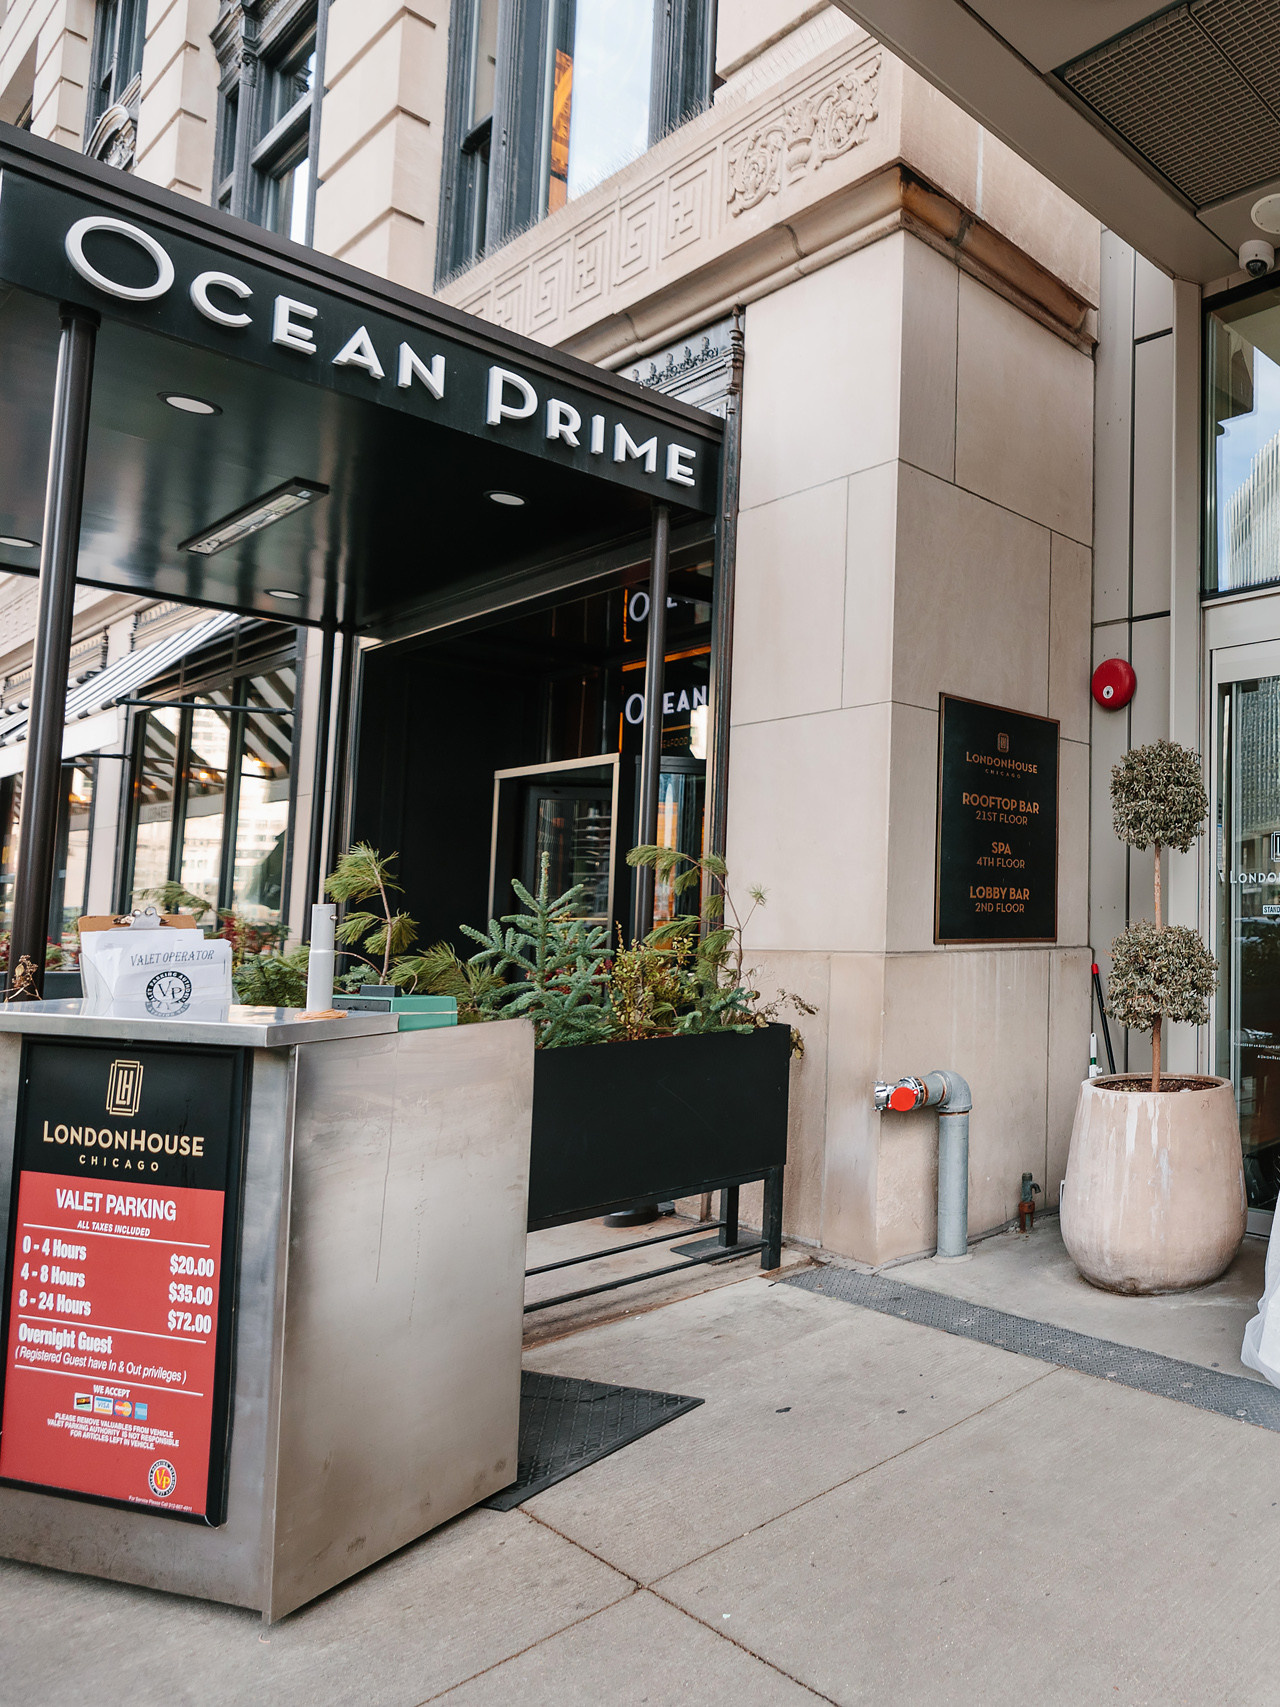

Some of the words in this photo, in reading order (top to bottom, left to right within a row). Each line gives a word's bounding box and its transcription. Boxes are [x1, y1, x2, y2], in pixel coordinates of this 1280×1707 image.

[64, 215, 446, 399] OCEAN
[486, 366, 697, 487] PRIME
[625, 685, 707, 725] OEAN
[966, 751, 1038, 774] LONDONHOUSE
[985, 768, 1021, 779] CHICAGO
[962, 792, 1018, 811] ROOFTOP
[1019, 800, 1040, 815] BAR
[976, 810, 998, 822] 21ST
[999, 813, 1028, 825] FLOOR
[991, 841, 1012, 855] SPA
[976, 856, 995, 867] 4TH
[996, 858, 1025, 869] FLOOR
[969, 885, 1008, 900] LOBBY
[1009, 887, 1030, 901] BAR
[975, 902, 994, 913] 2ND
[996, 903, 1025, 913] FLOOR
[130, 953, 162, 966] VALET
[162, 949, 215, 964] OPERATOR
[43, 1120, 205, 1157] LONDONHOUSE
[79, 1154, 159, 1172] CHICAGO
[56, 1188, 104, 1213] VALET
[105, 1194, 177, 1221] PARKING
[77, 1220, 90, 1230] ALL
[92, 1222, 113, 1233] TAXES
[114, 1224, 151, 1237] INCLUDED
[22, 1235, 32, 1254] 0
[41, 1238, 51, 1256] 4
[52, 1239, 87, 1261] Hours
[20, 1262, 30, 1280] 4
[39, 1264, 49, 1283] 8
[51, 1265, 86, 1288] Hours
[169, 1253, 215, 1278] $20.00
[18, 1289, 28, 1307] 8
[38, 1291, 54, 1311] 24
[56, 1294, 92, 1316] Hours
[168, 1281, 214, 1306] $35.00
[167, 1309, 212, 1334] $72.00
[18, 1323, 76, 1350] Overnight
[78, 1331, 113, 1354] Guest
[63, 1352, 87, 1367] Guest
[87, 1356, 108, 1370] have
[108, 1359, 117, 1372] In
[118, 1360, 125, 1373] &
[126, 1361, 142, 1376] Out
[93, 1384, 105, 1394] WE
[105, 1386, 131, 1398] ACCEPT
[97, 1401, 110, 1409] VISA
[47, 1418, 64, 1428] VALET
[64, 1421, 89, 1432] PARKING
[90, 1425, 121, 1437] AUTHORITY
[128, 1432, 140, 1440] NOT
[141, 1434, 180, 1447] RESPONSIBLE
[55, 1412, 77, 1422] PLEASE
[77, 1415, 100, 1426] REMOVE
[101, 1419, 132, 1432] VALUABLES
[133, 1425, 149, 1434] FROM
[150, 1428, 174, 1439] VEHICLE
[70, 1429, 82, 1438] FOR
[82, 1431, 109, 1443] ARTICLES
[109, 1435, 123, 1445] LEFT
[123, 1438, 130, 1446] IN
